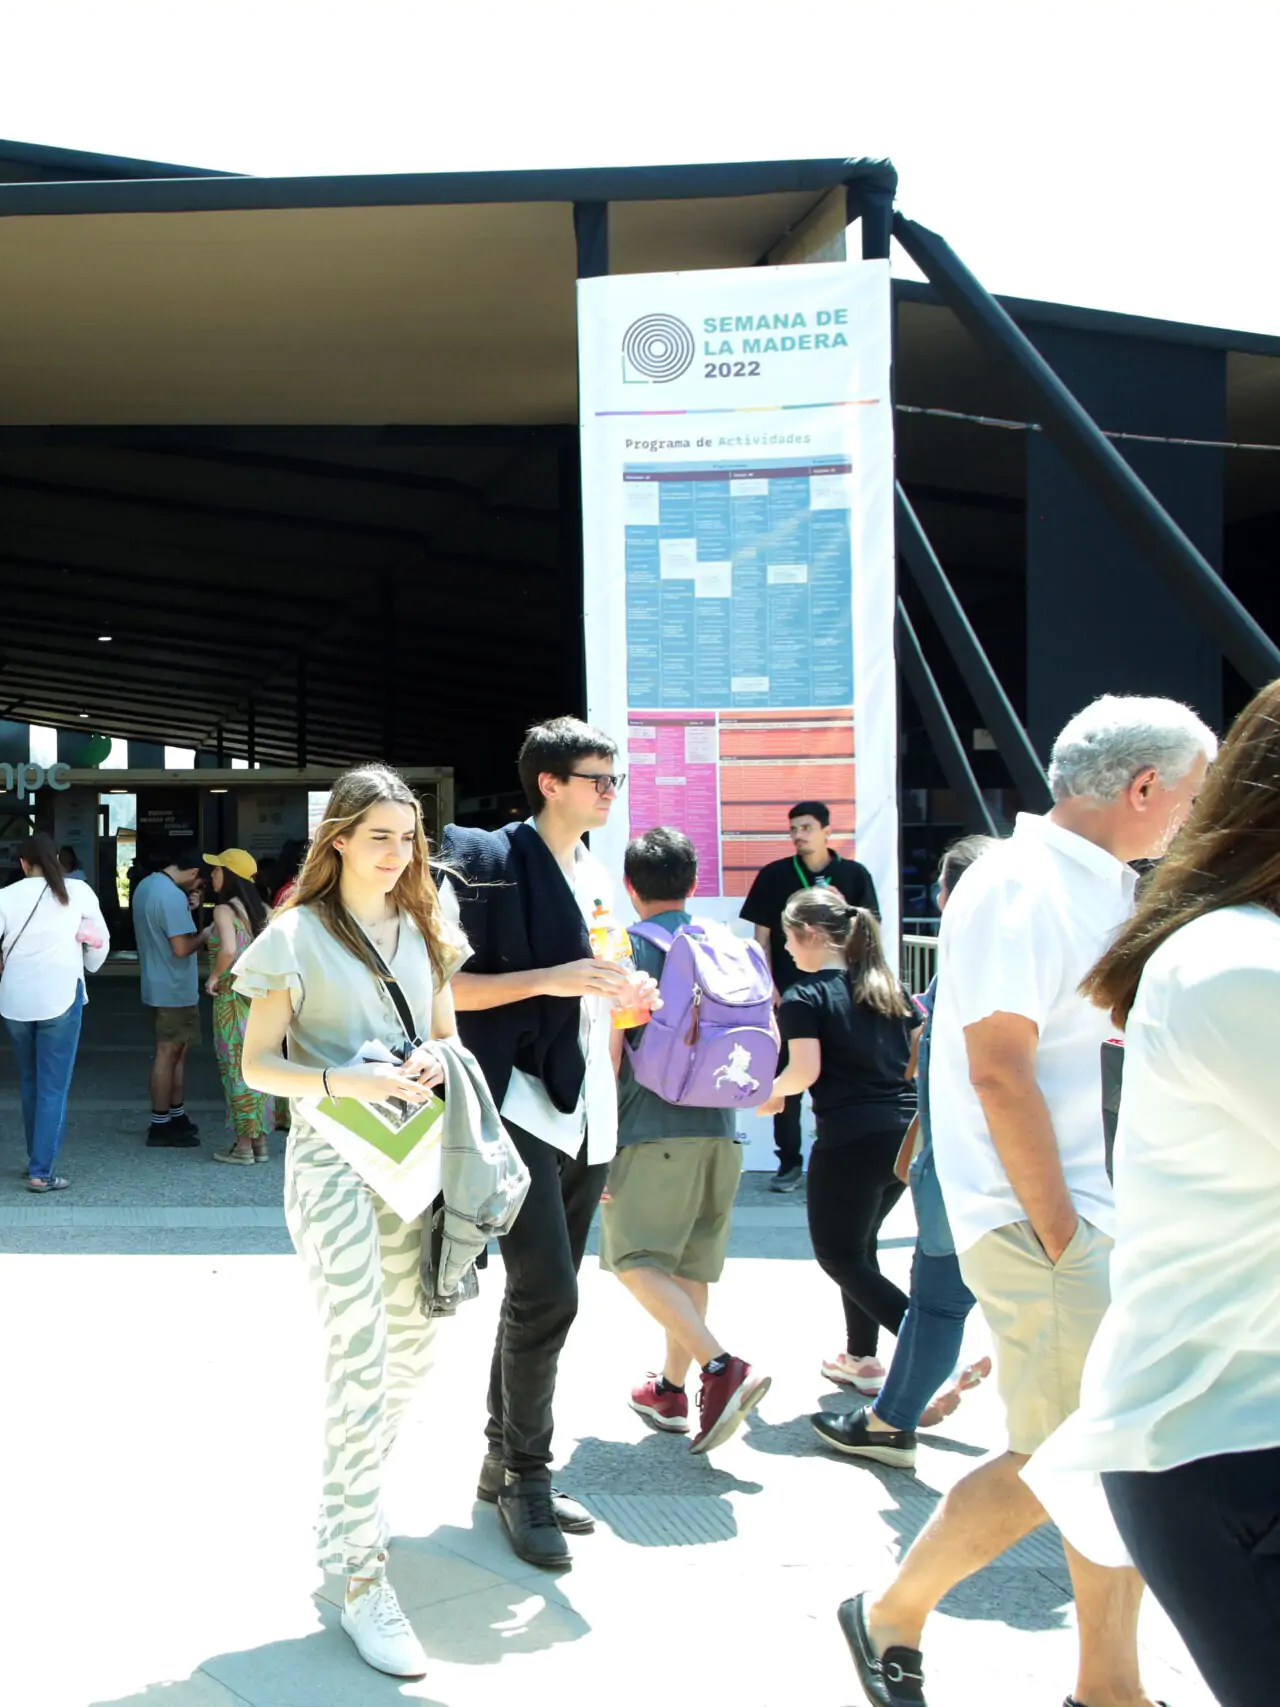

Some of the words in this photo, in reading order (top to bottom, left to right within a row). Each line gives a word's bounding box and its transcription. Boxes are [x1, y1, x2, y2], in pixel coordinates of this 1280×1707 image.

[703, 313, 807, 333] SEMANA
[816, 308, 848, 326] DE
[704, 340, 734, 356] LA
[742, 332, 849, 354] MADERA
[704, 361, 761, 379] 2022
[625, 438, 691, 452] Programa
[696, 437, 712, 448] de
[718, 432, 811, 447] Actividades
